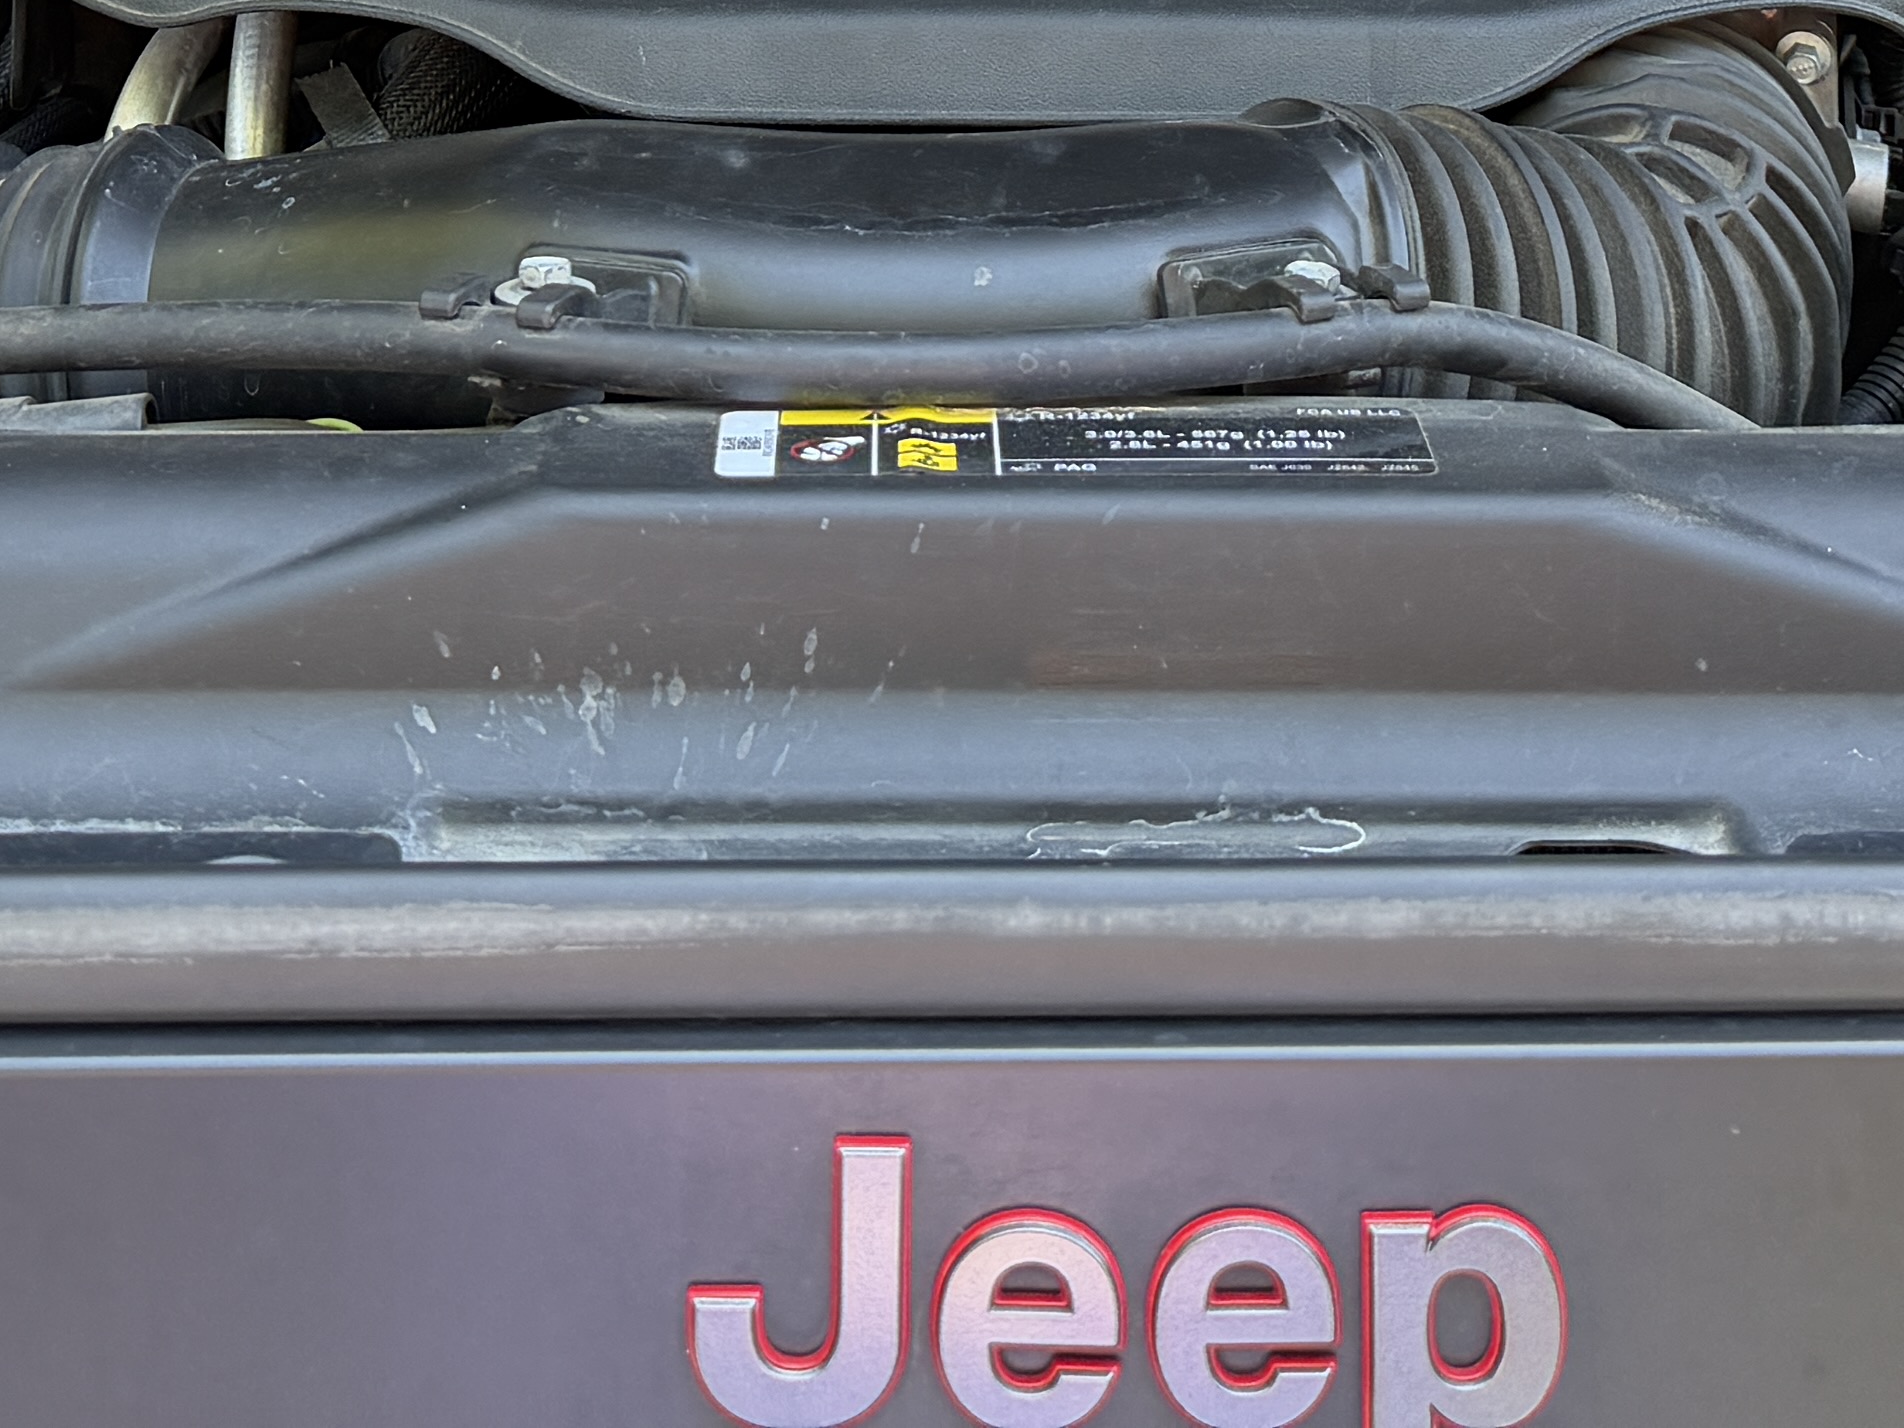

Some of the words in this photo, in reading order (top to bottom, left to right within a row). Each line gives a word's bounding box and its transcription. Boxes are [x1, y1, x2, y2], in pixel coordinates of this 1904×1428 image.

[1296, 408, 1332, 417] FCA
[1337, 408, 1361, 417] US
[1367, 409, 1401, 417] LLC
[686, 1132, 1569, 1428] Jeep
